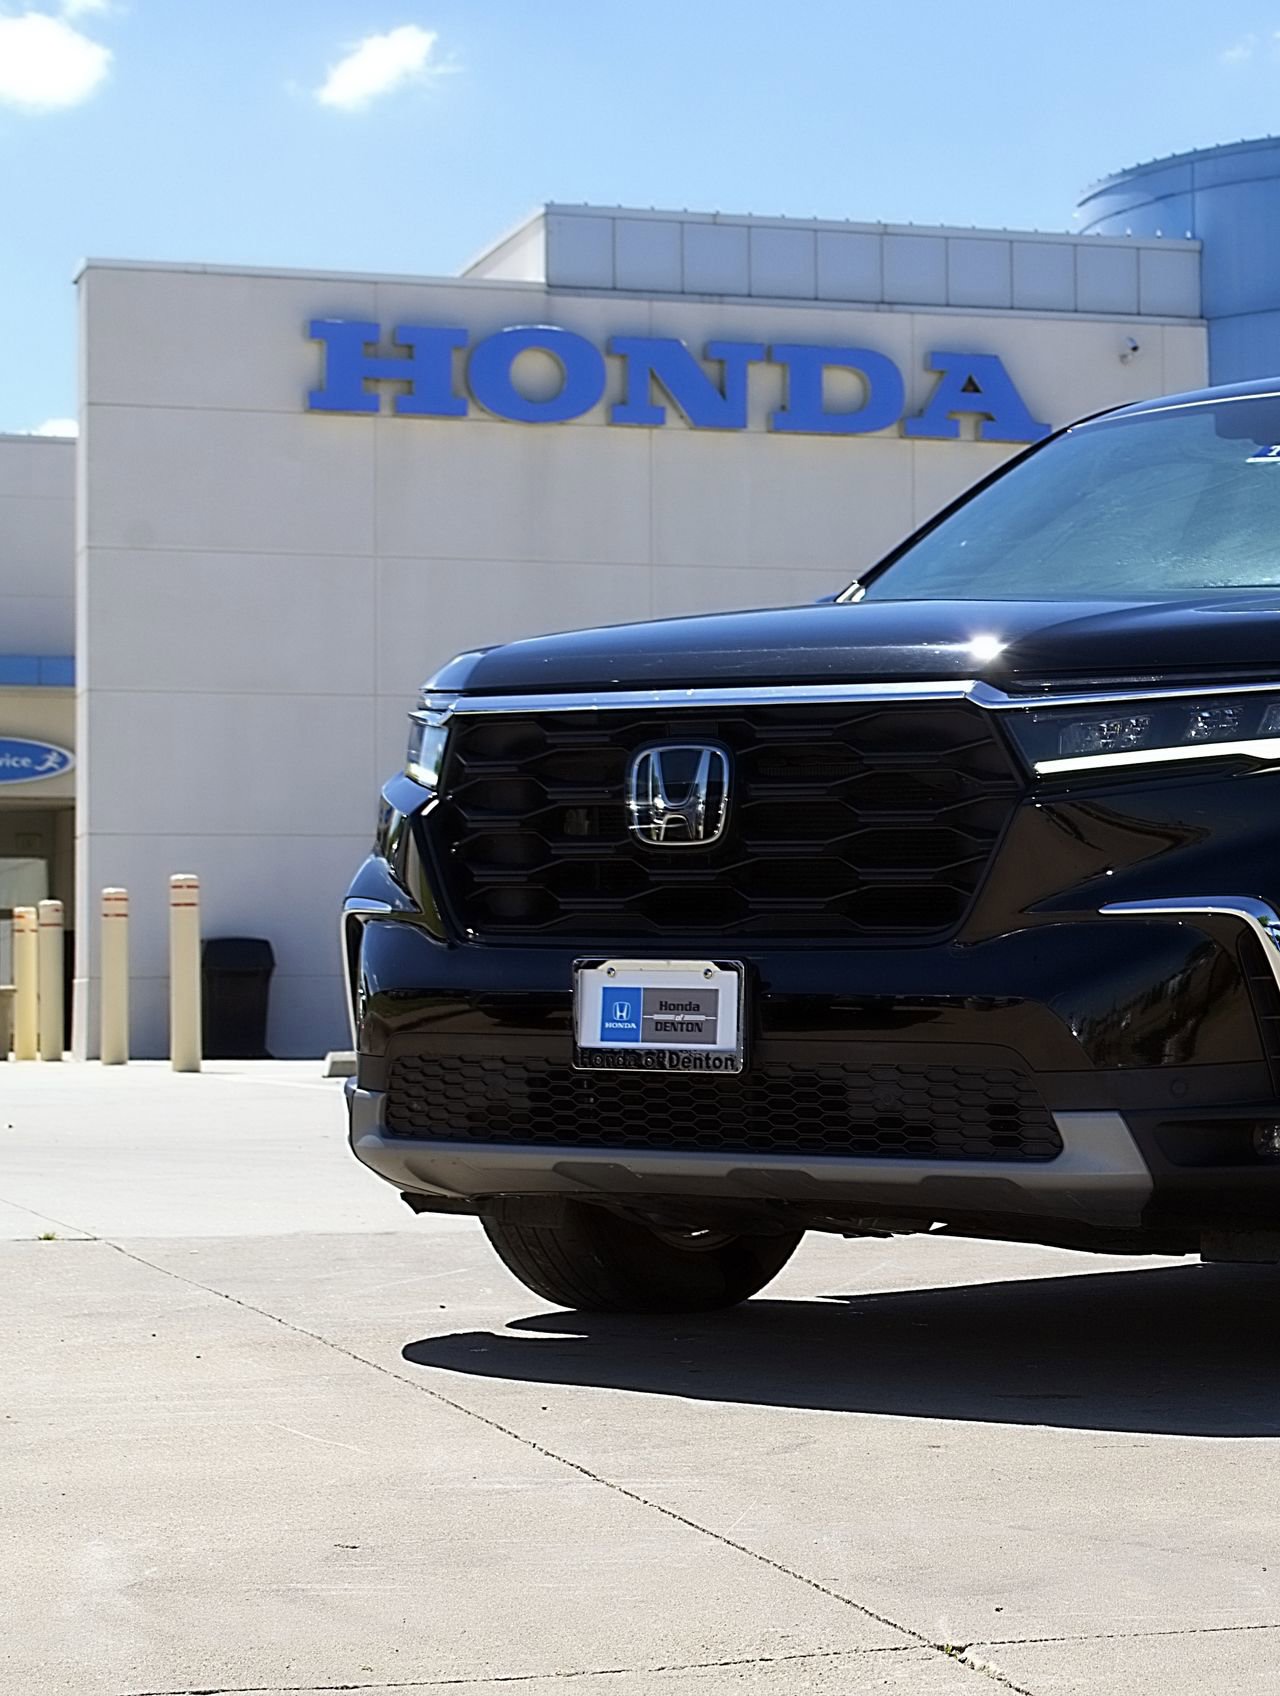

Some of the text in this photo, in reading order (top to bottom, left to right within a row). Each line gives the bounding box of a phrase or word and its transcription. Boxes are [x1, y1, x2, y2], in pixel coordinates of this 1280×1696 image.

[308, 318, 1052, 443] HONDA
[659, 1001, 700, 1012] Honda
[655, 1022, 703, 1032] DENTON
[580, 1050, 637, 1068] Honda
[668, 1051, 736, 1070] Denton
